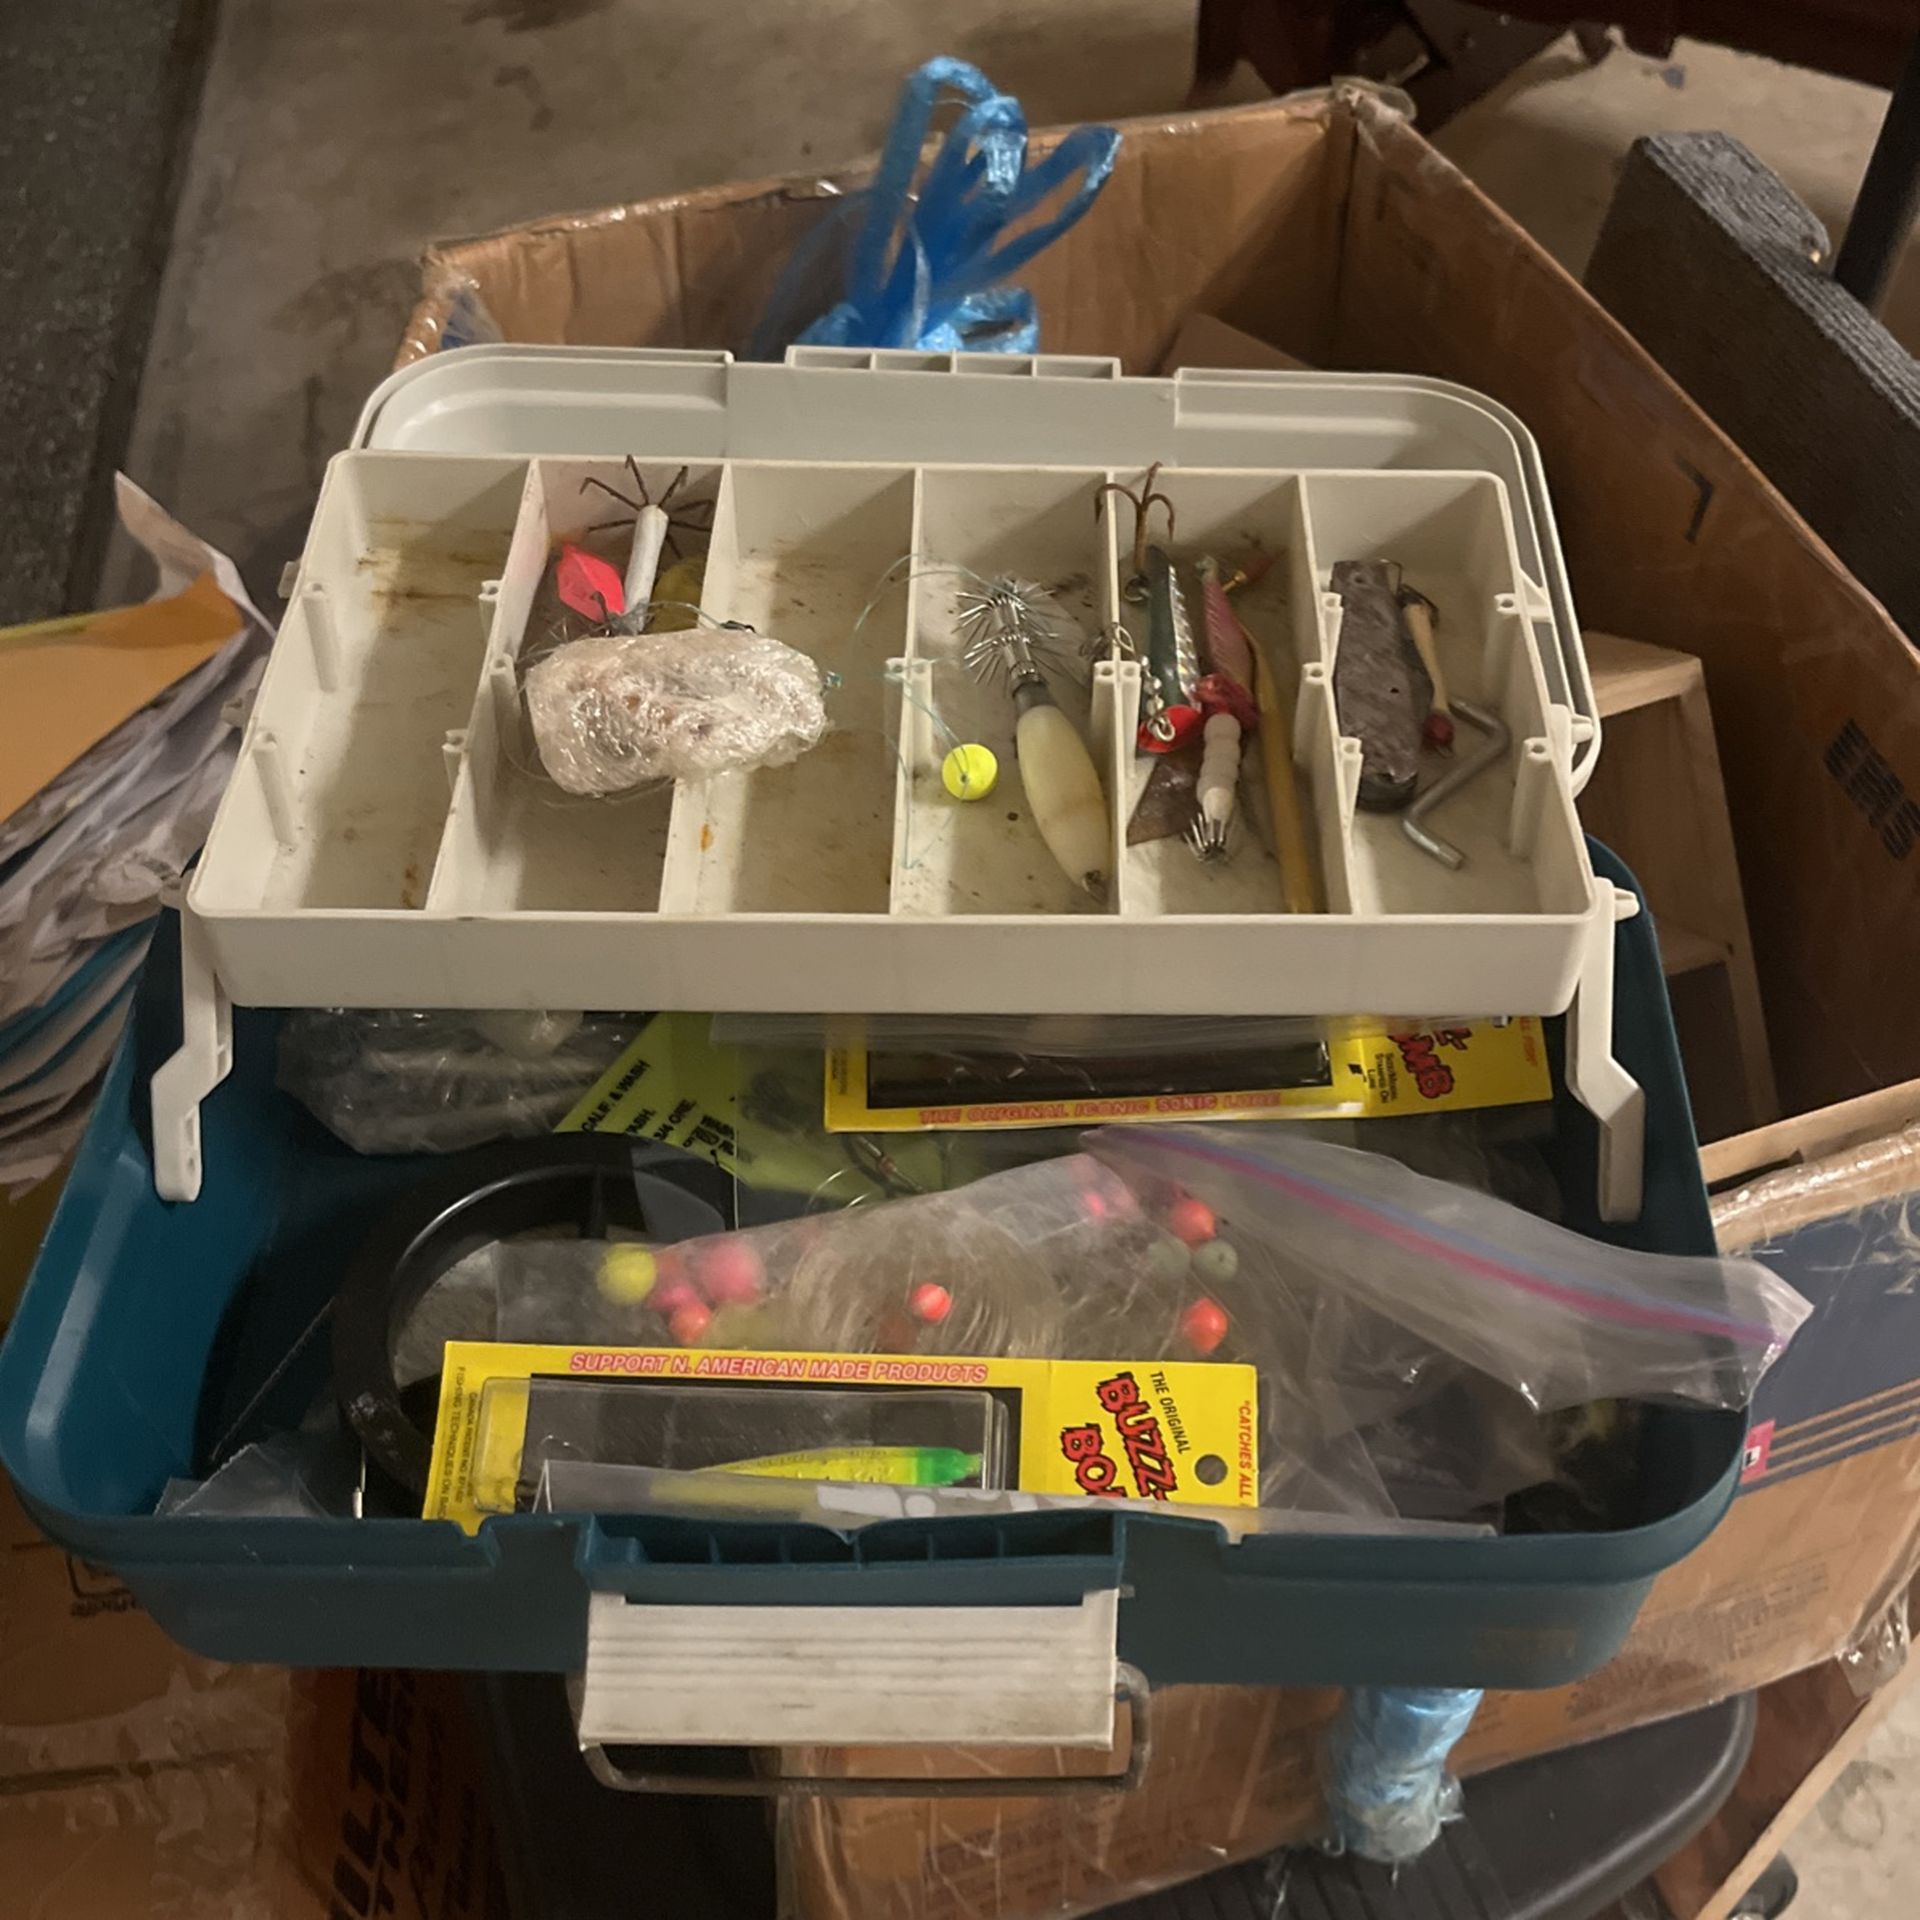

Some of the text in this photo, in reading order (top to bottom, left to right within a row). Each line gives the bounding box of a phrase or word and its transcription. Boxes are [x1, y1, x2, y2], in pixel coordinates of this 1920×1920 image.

[919, 1109, 961, 1125] THE
[967, 1103, 1069, 1123] ORIGINAL
[1155, 1094, 1219, 1113] SONIC
[570, 1352, 988, 1383] SUPPORT N. AMERICAN MADE PRODUCTS
[1150, 1371, 1191, 1455] THE ORIGINAL
[444, 1410, 461, 1479] TECHNIQUES
[1238, 1473, 1252, 1498] ALL
